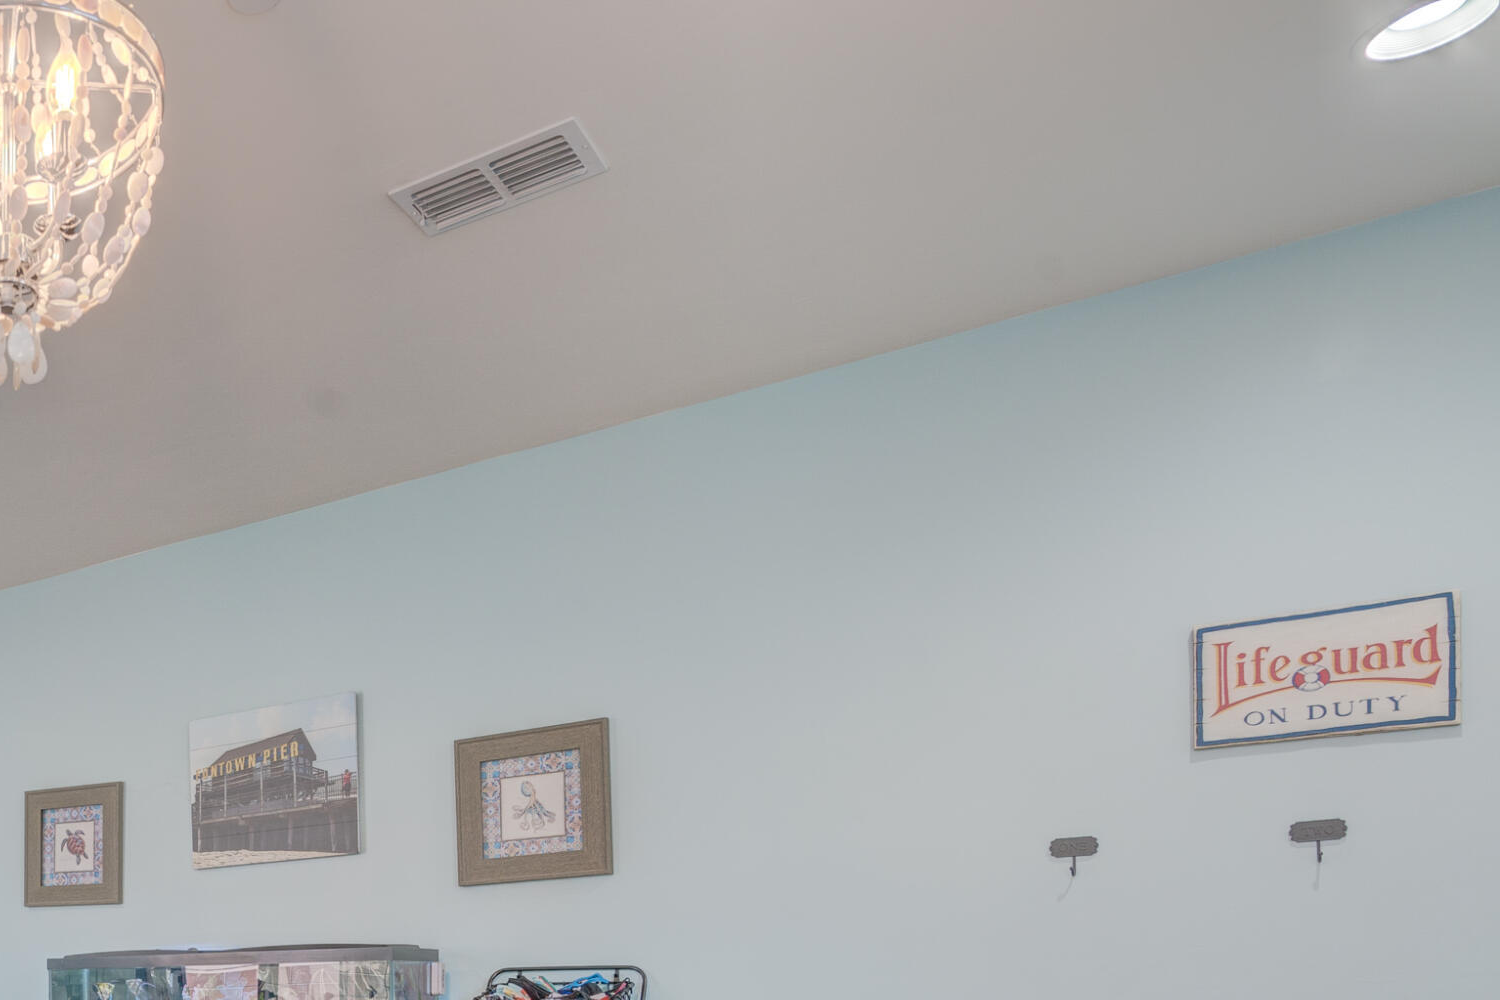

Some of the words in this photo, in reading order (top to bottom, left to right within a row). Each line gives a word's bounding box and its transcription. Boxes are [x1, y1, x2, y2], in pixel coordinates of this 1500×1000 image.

[1211, 623, 1443, 718] Lifeguard
[1243, 707, 1289, 727] ON
[1307, 695, 1407, 720] DUTY
[263, 741, 299, 765] PIER
[1058, 840, 1088, 853] ONE
